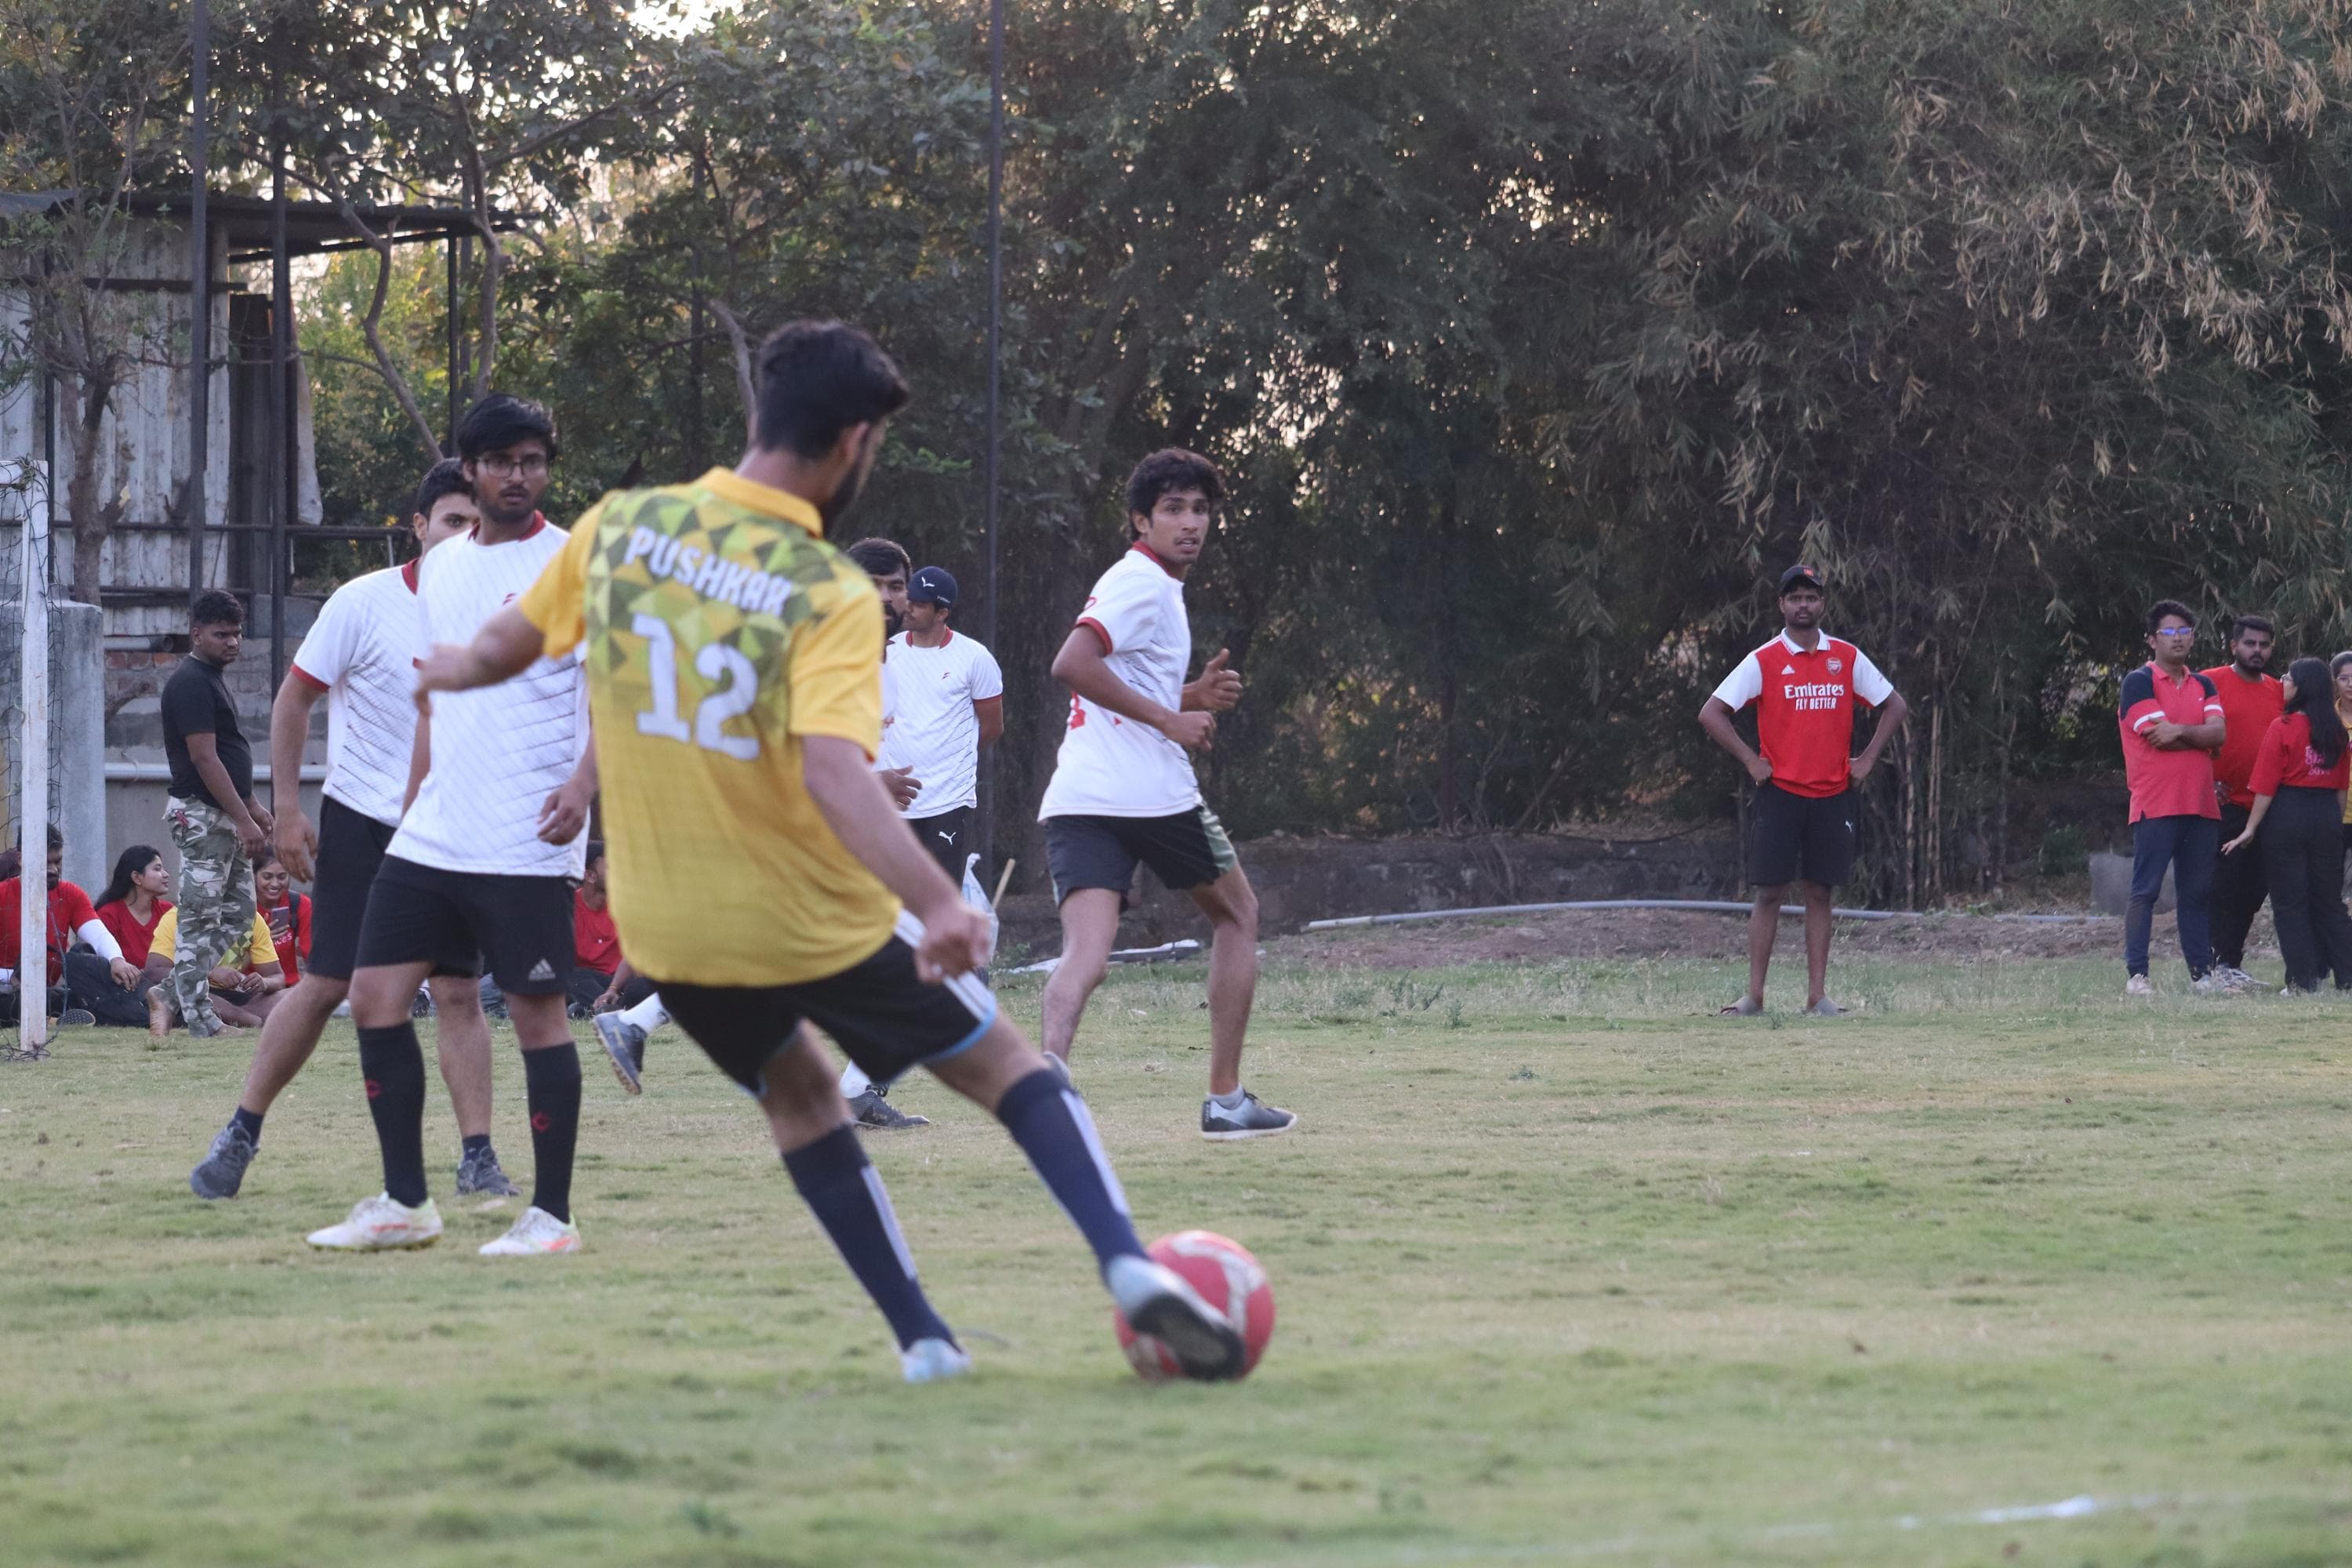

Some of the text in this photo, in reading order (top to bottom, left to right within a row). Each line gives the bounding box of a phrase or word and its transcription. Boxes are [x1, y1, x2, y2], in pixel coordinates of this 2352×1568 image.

[623, 524, 793, 617] PUSHKAR
[630, 612, 760, 761] 12
[1784, 682, 1845, 699] Emirates
[1795, 697, 1837, 710] FLY BETTER
